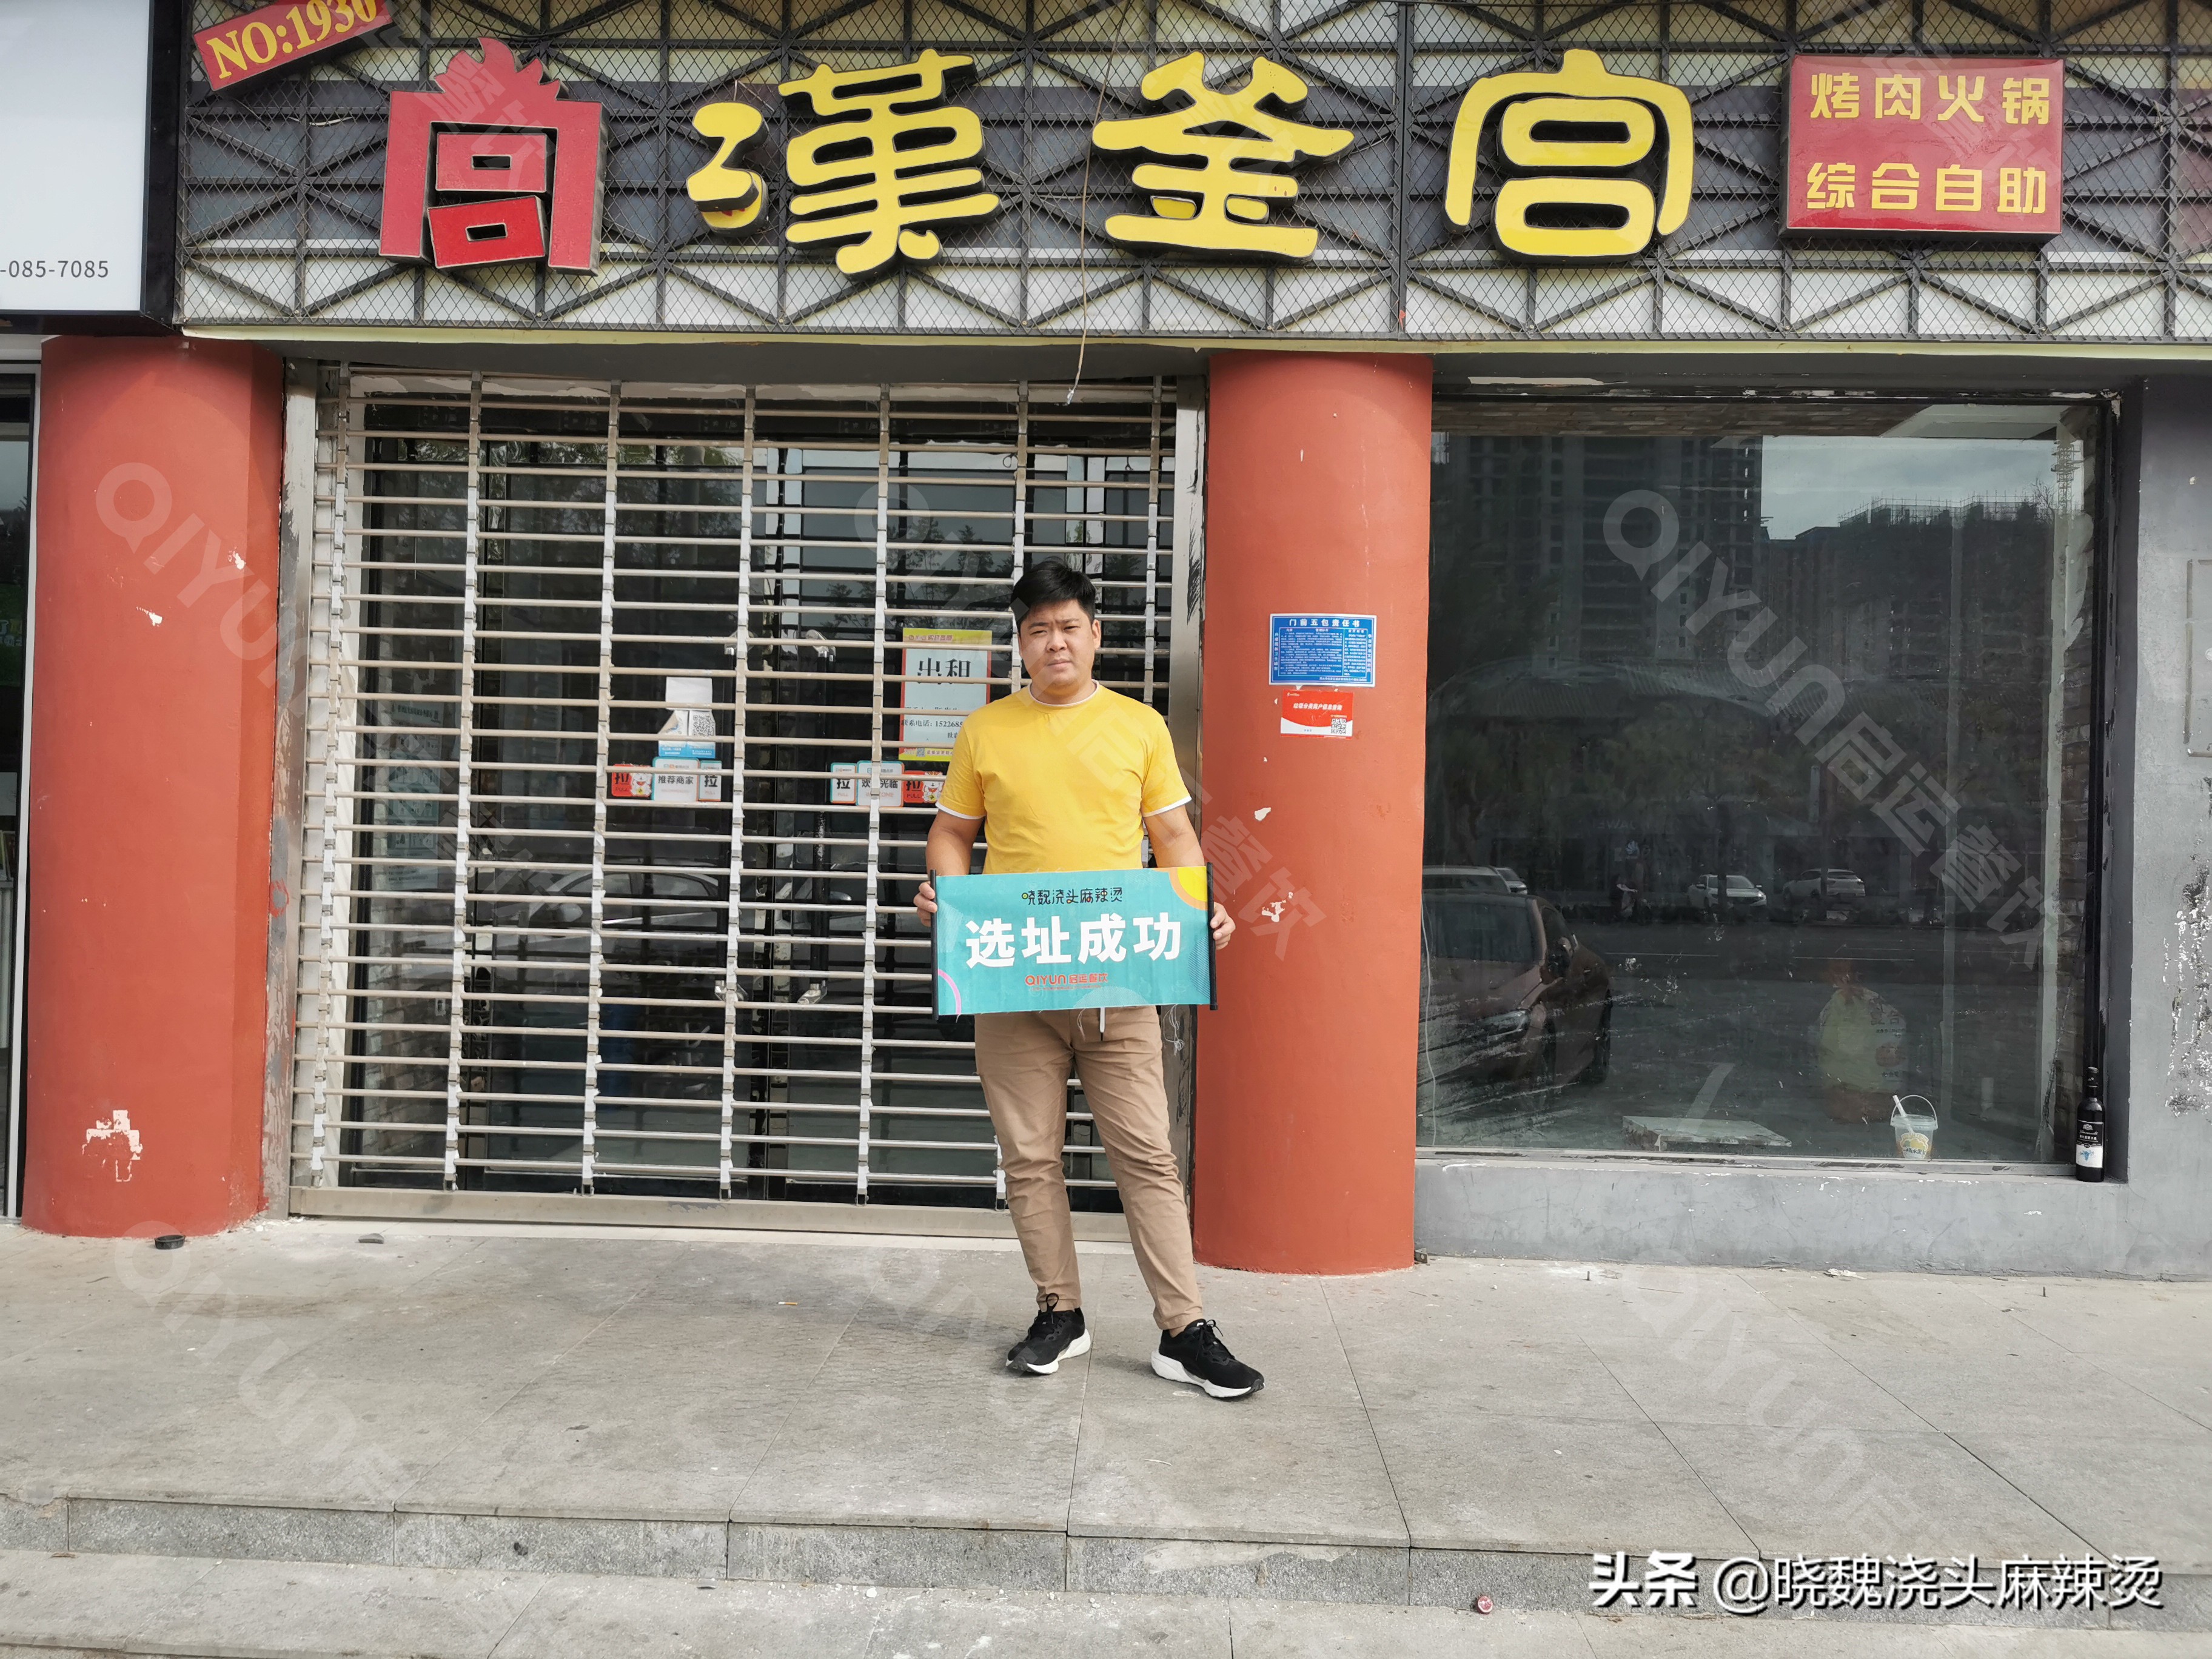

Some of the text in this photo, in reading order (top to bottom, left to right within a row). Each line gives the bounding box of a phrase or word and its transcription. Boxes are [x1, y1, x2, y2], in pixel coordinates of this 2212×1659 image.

[1810, 71, 2050, 124] 烤肉火锅
[1806, 162, 2047, 214] 综合自助
[1289, 618, 1361, 628] 门前五包责任书
[917, 657, 974, 685] 出租
[658, 775, 694, 785] 推荐商家
[705, 775, 718, 787] 拉
[836, 779, 850, 789] 拉
[862, 779, 899, 789] 欢光临
[1021, 886, 1123, 905] 晓魏浇头麻辣烫
[965, 911, 1181, 969] 选址成功
